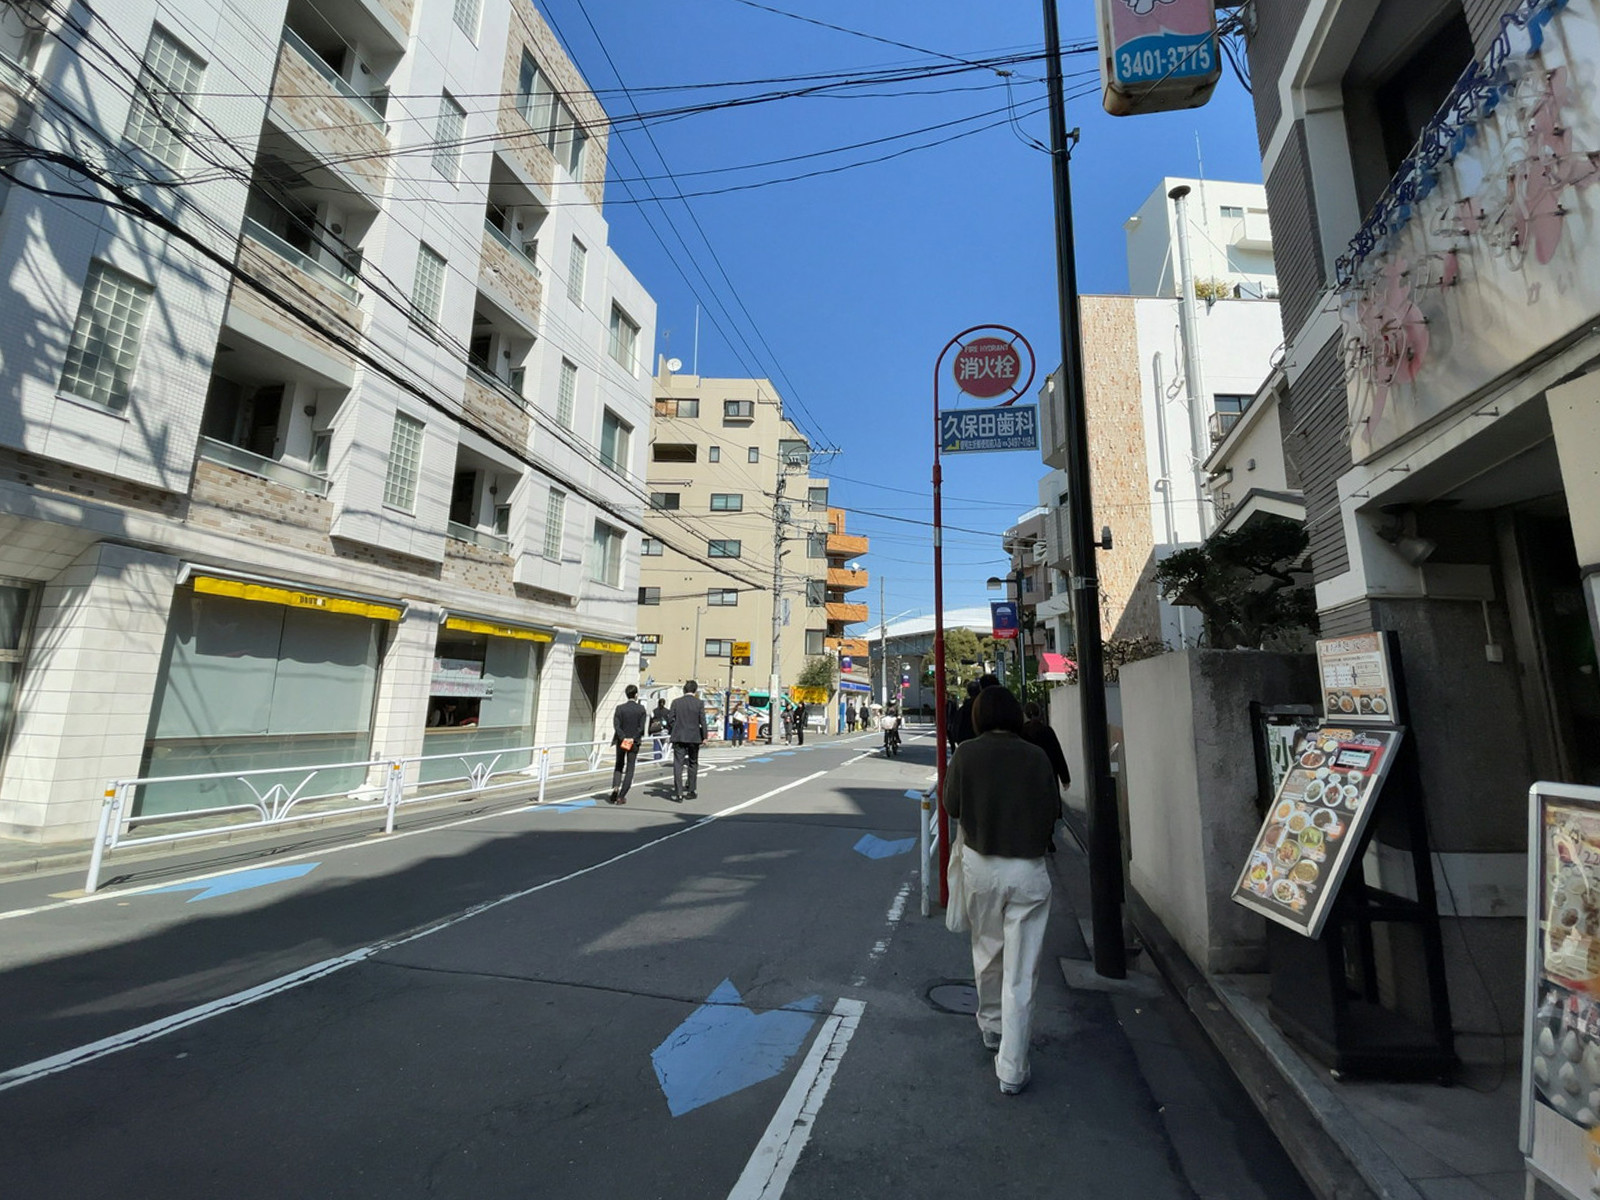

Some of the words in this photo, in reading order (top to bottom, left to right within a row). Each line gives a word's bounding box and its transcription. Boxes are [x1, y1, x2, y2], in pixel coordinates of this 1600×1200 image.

[1122, 44, 1209, 78] 3401-3775
[960, 355, 1015, 380] 消火栓
[944, 410, 1034, 440] 久保田歯科
